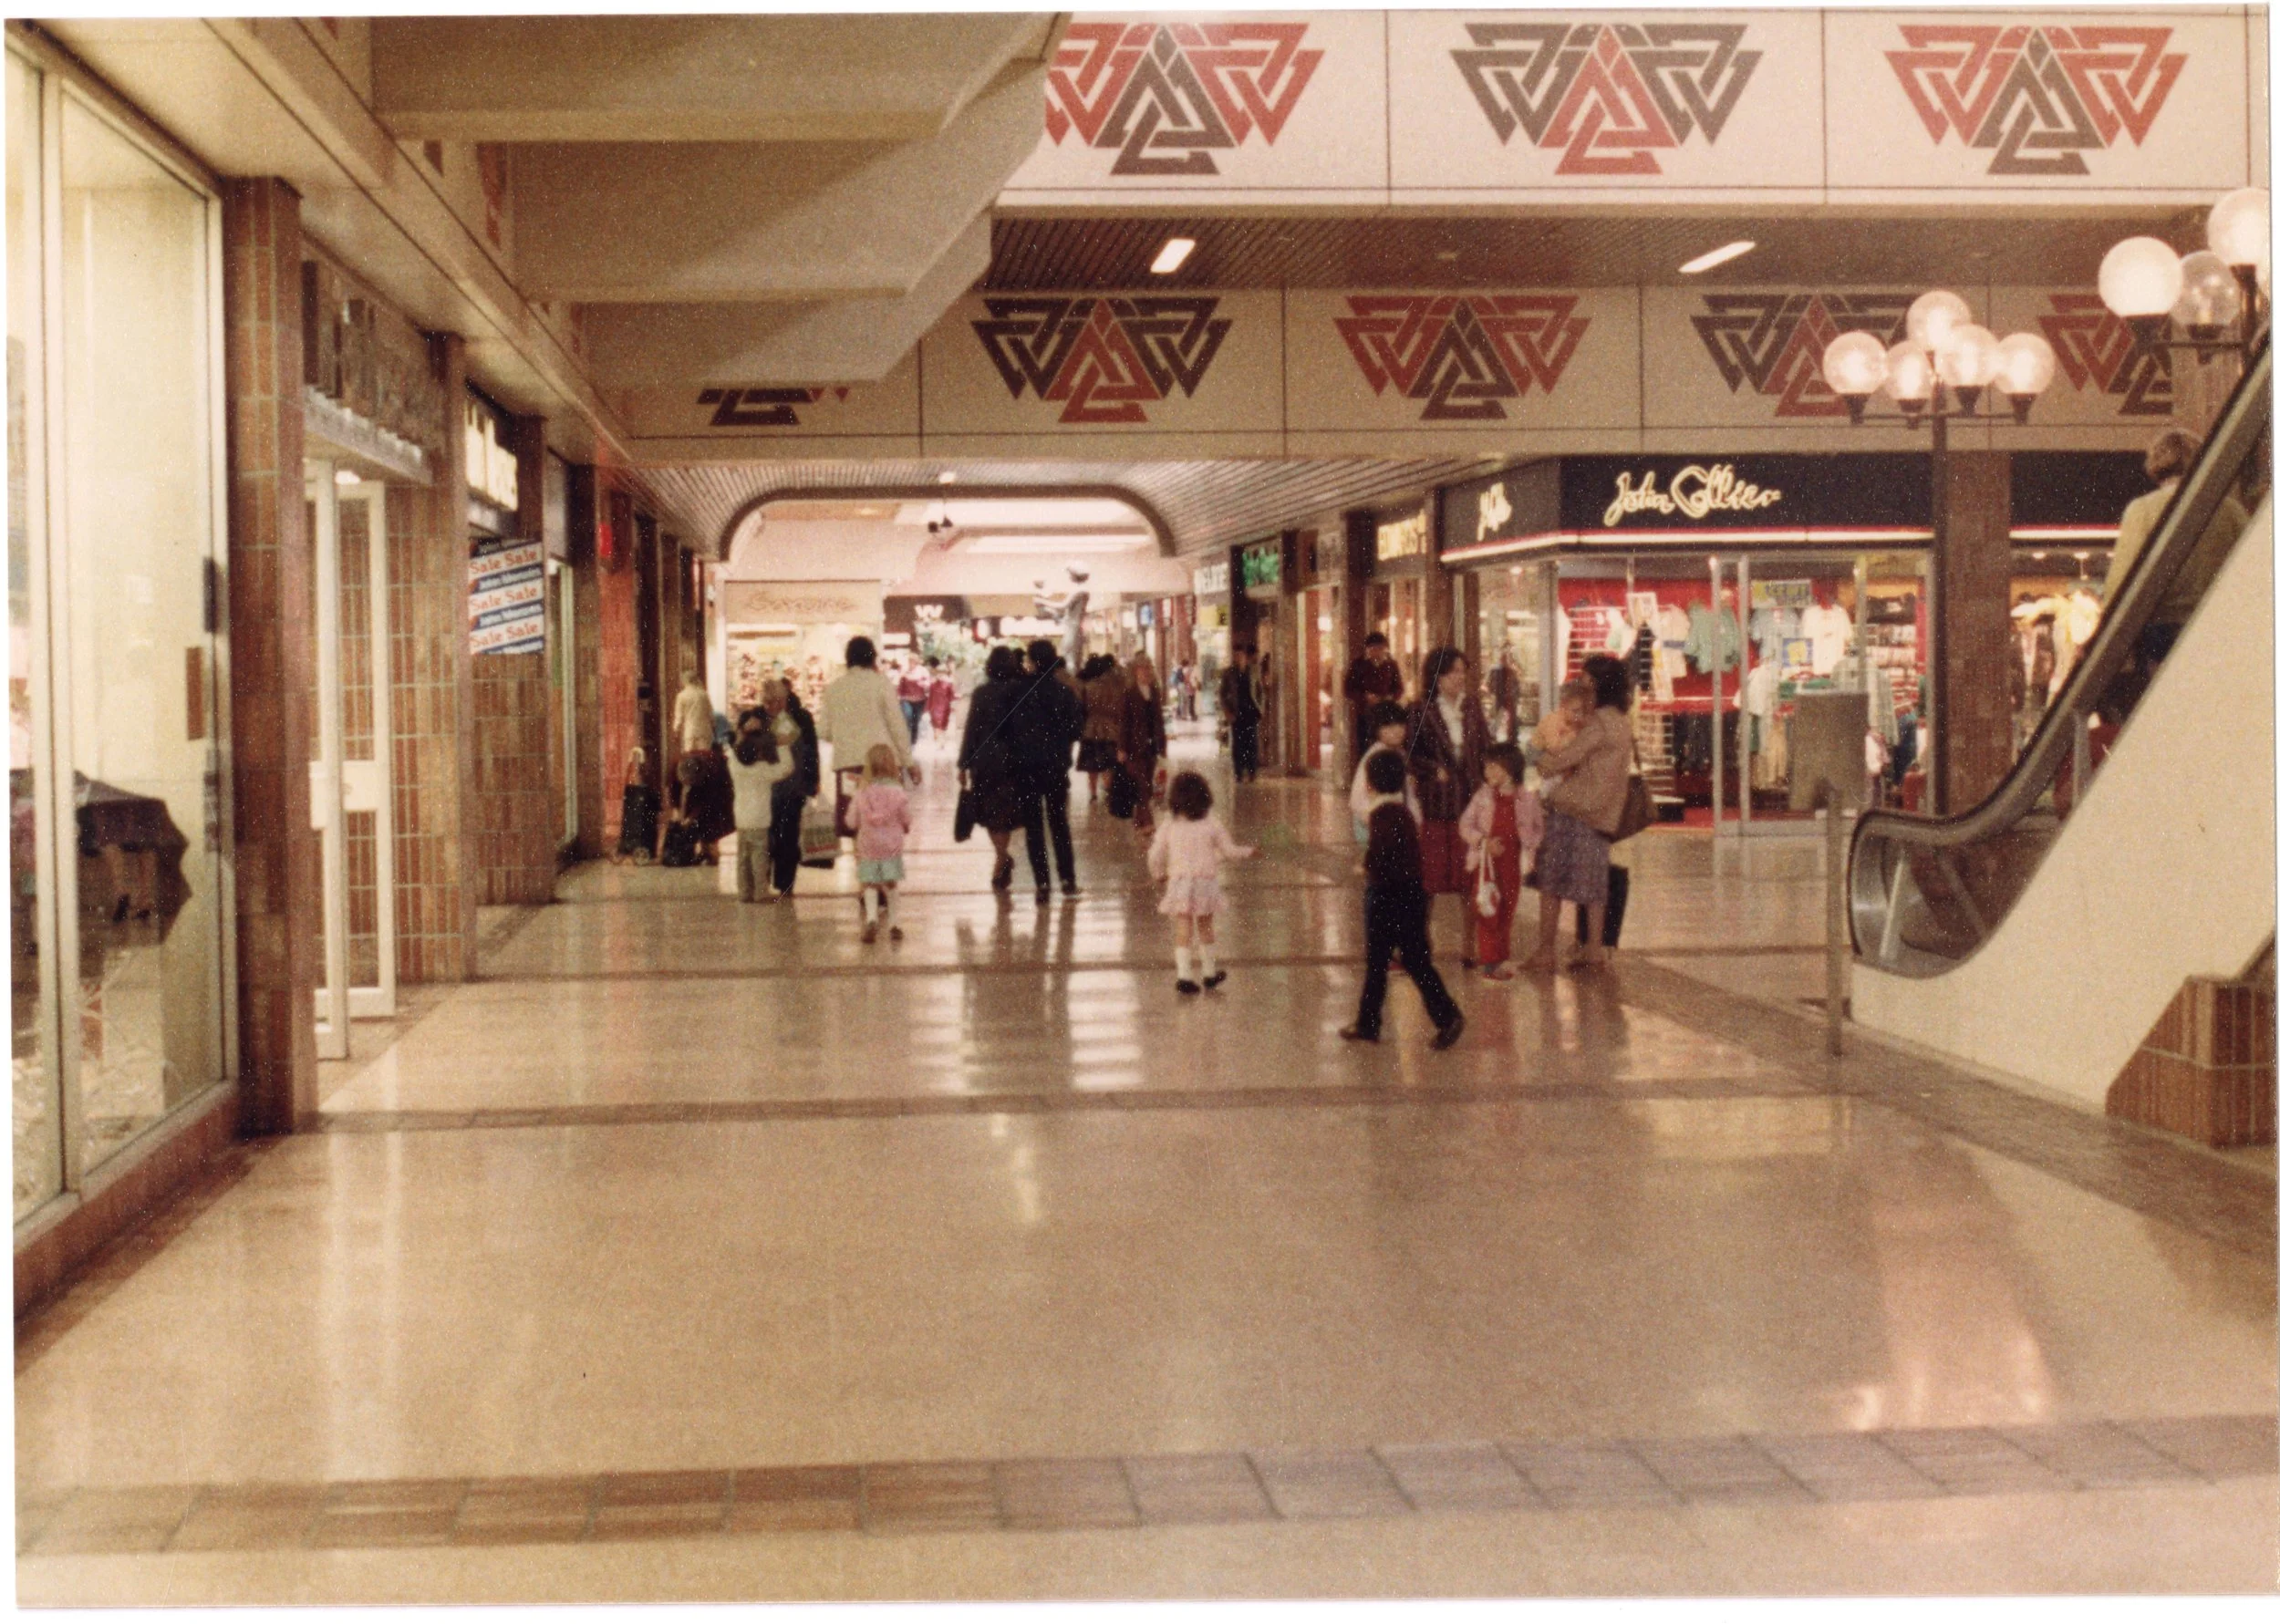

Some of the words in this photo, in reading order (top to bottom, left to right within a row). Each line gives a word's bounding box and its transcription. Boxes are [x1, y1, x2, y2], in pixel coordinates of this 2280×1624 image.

[1603, 471, 1675, 527] John
[1670, 463, 1782, 519] Collier
[470, 557, 501, 574] Sale
[505, 548, 537, 565] Sale
[470, 595, 501, 612] Sale
[505, 586, 537, 604] Sale
[470, 631, 502, 646] Sale
[506, 622, 538, 638] Sale
